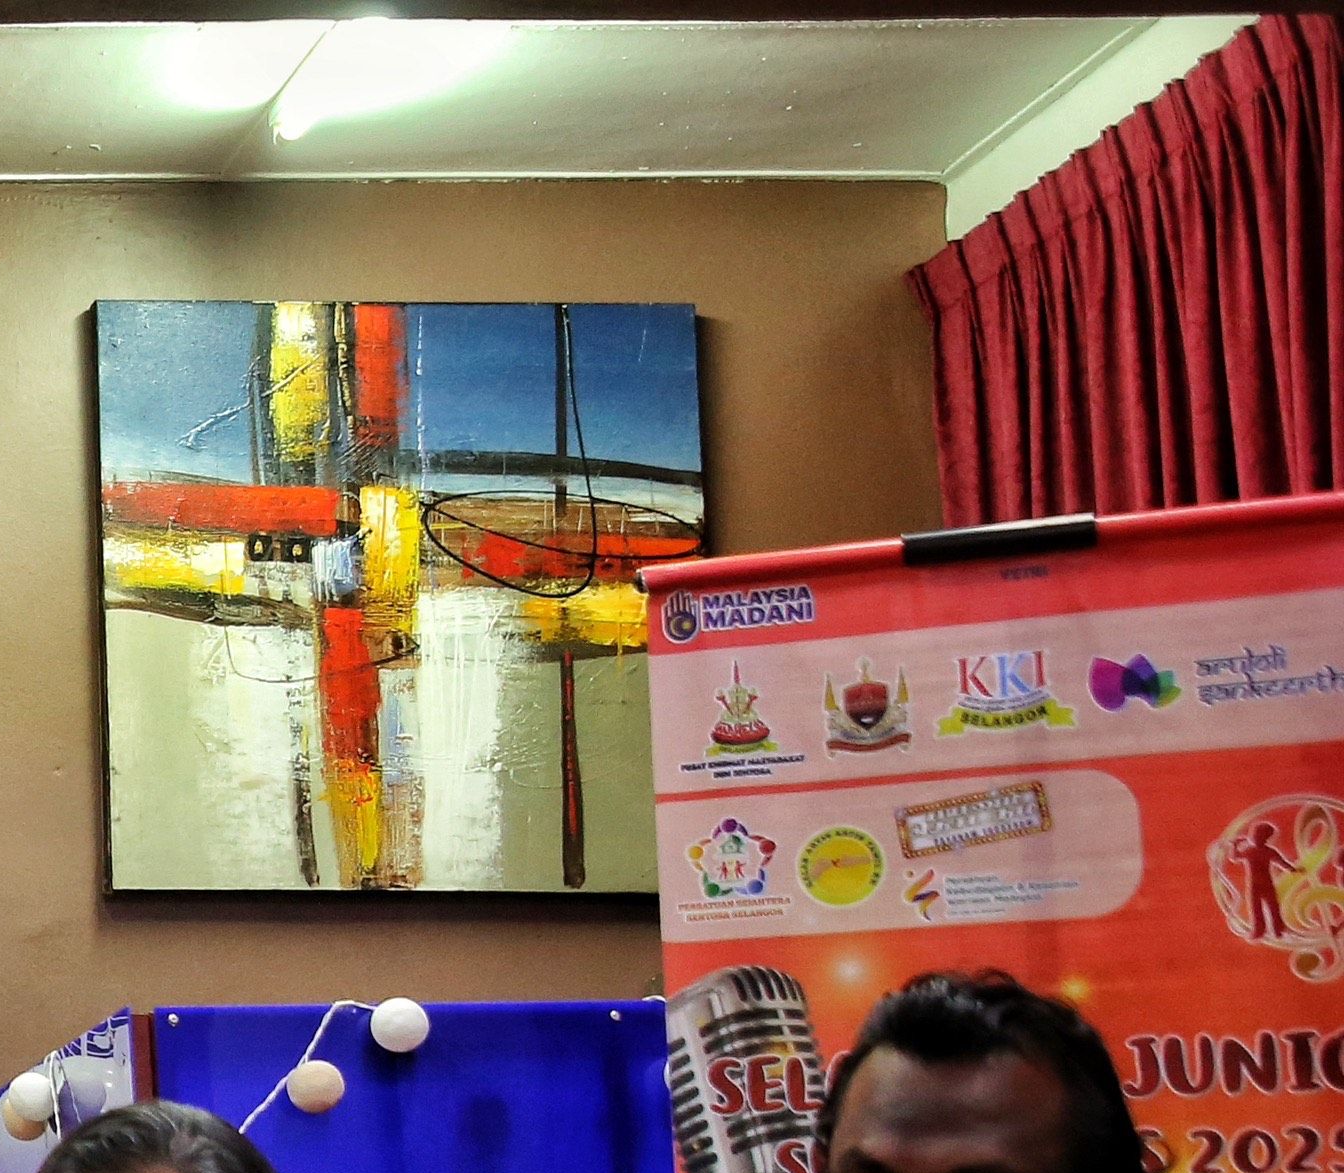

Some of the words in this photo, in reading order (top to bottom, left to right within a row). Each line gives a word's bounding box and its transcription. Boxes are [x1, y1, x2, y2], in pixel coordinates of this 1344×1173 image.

[702, 585, 812, 611] MALAYSIA
[702, 600, 813, 630] MADANI
[957, 650, 1046, 698] KKI
[960, 704, 1049, 728] SELANGOR
